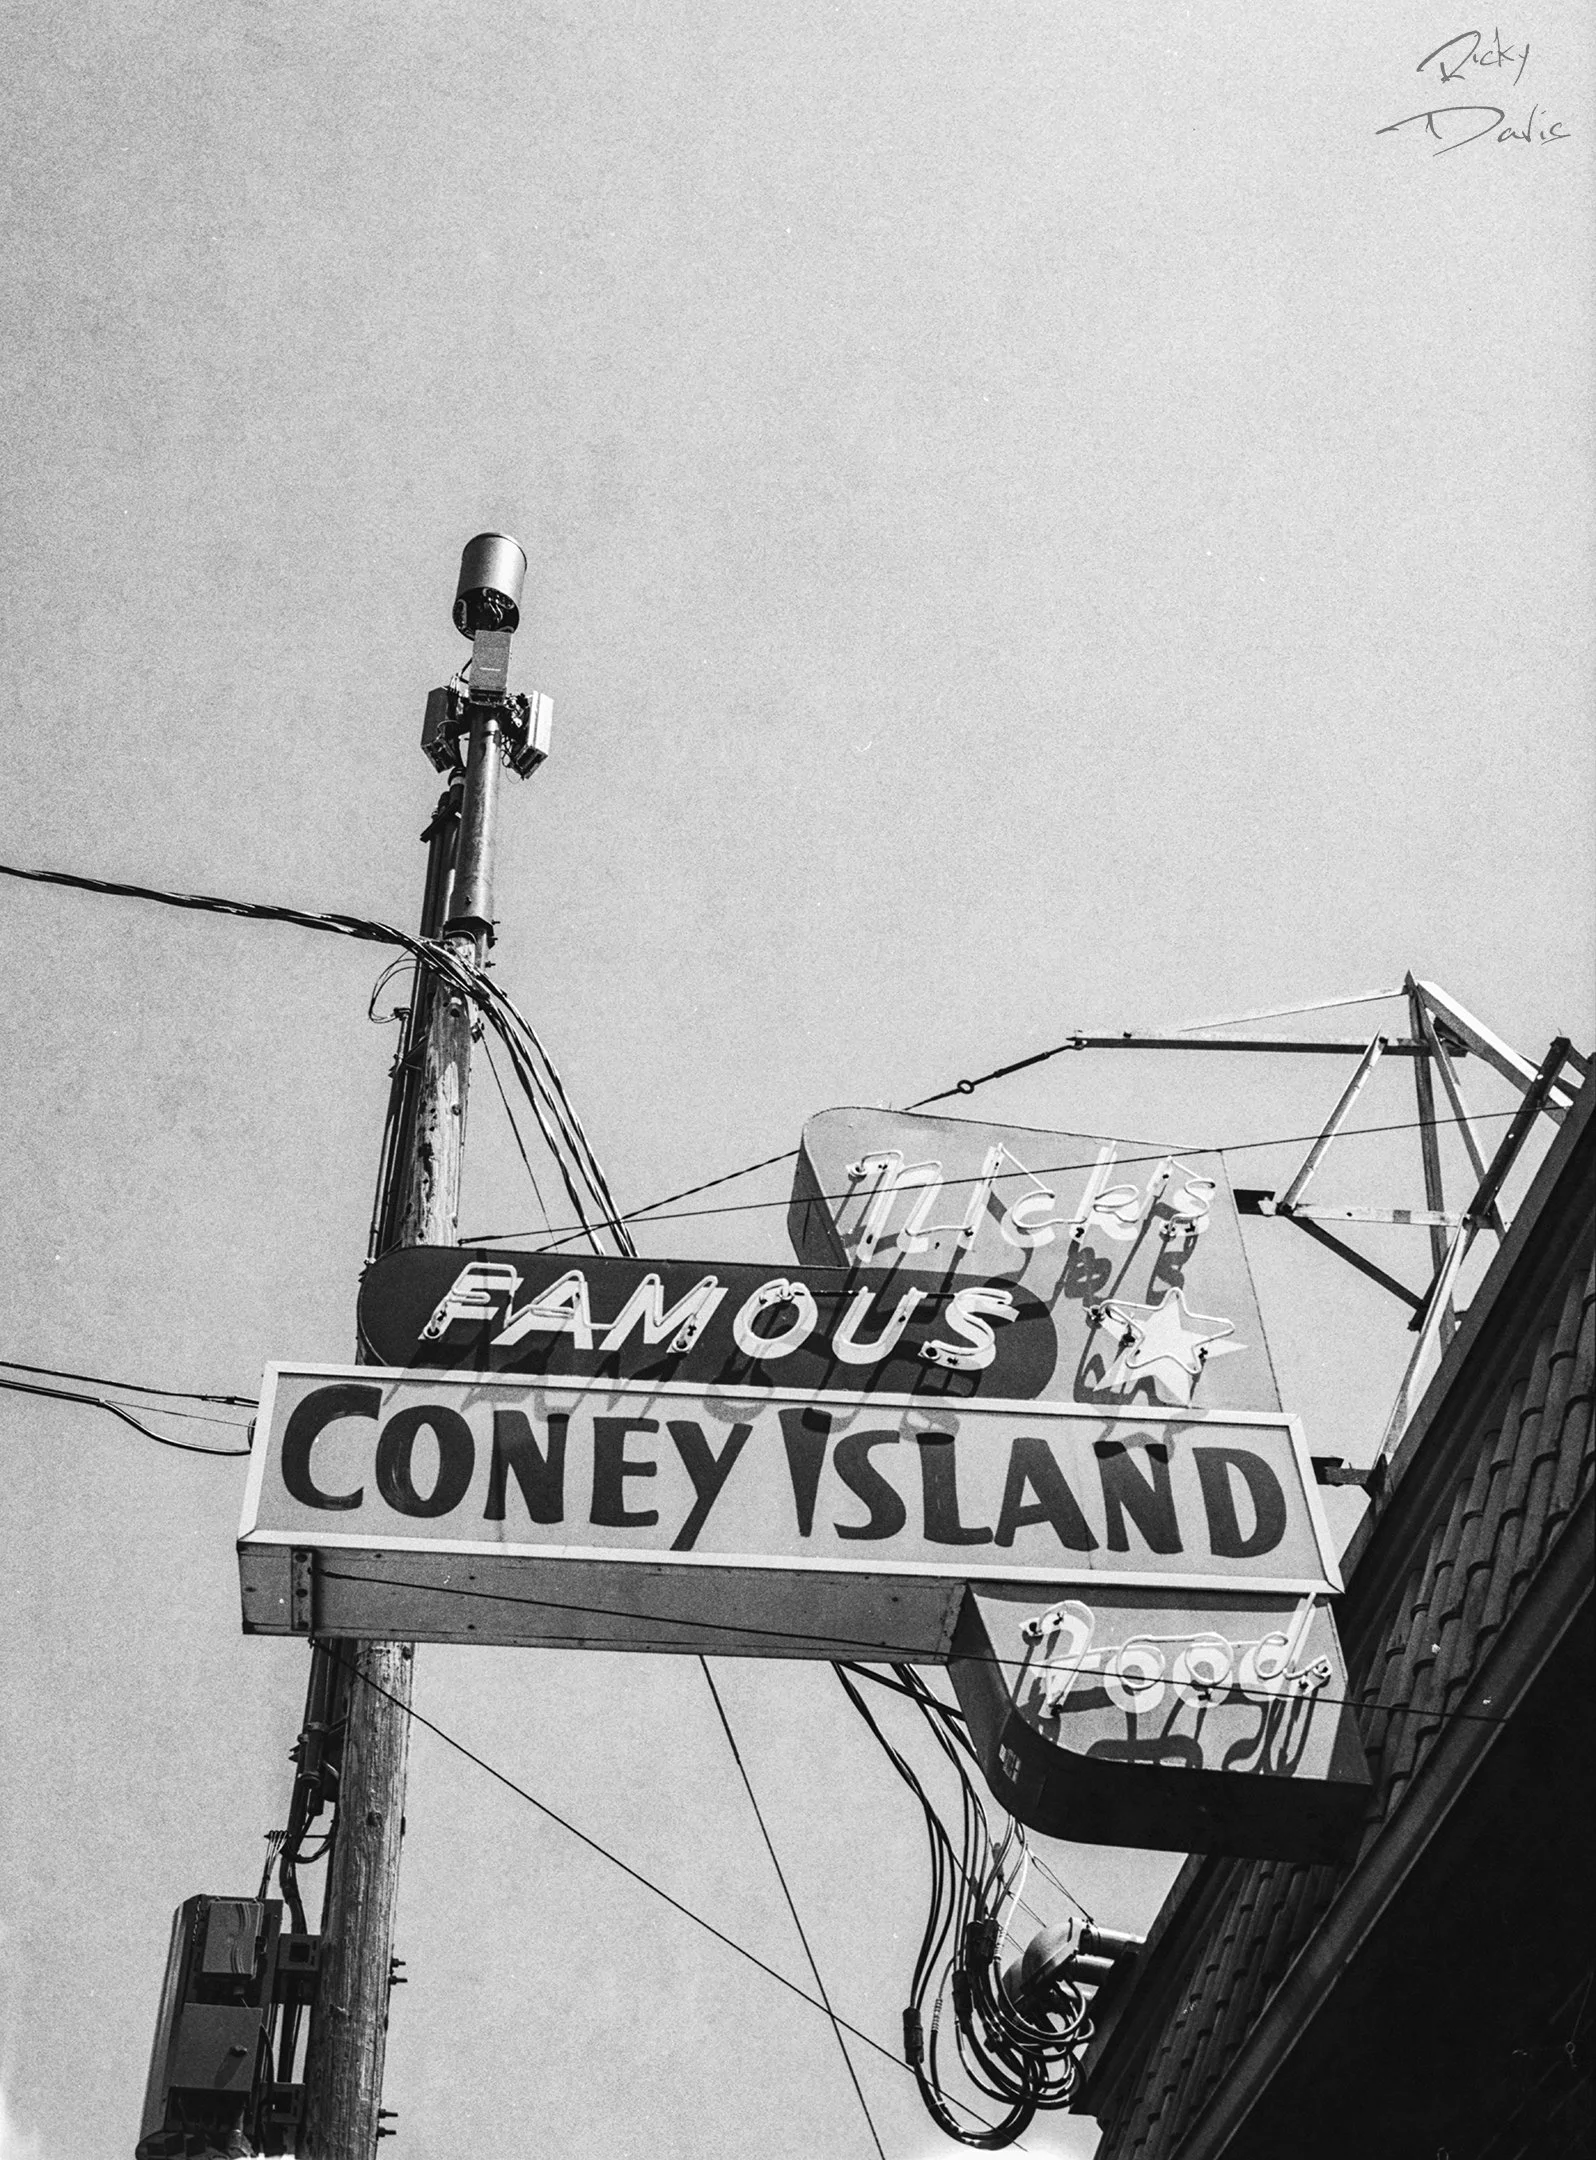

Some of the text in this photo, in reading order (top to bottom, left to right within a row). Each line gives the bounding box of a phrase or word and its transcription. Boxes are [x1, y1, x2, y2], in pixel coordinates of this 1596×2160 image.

[418, 1261, 1019, 1371] FAMOUS
[281, 1383, 1287, 1558] CONEY ISLAND
